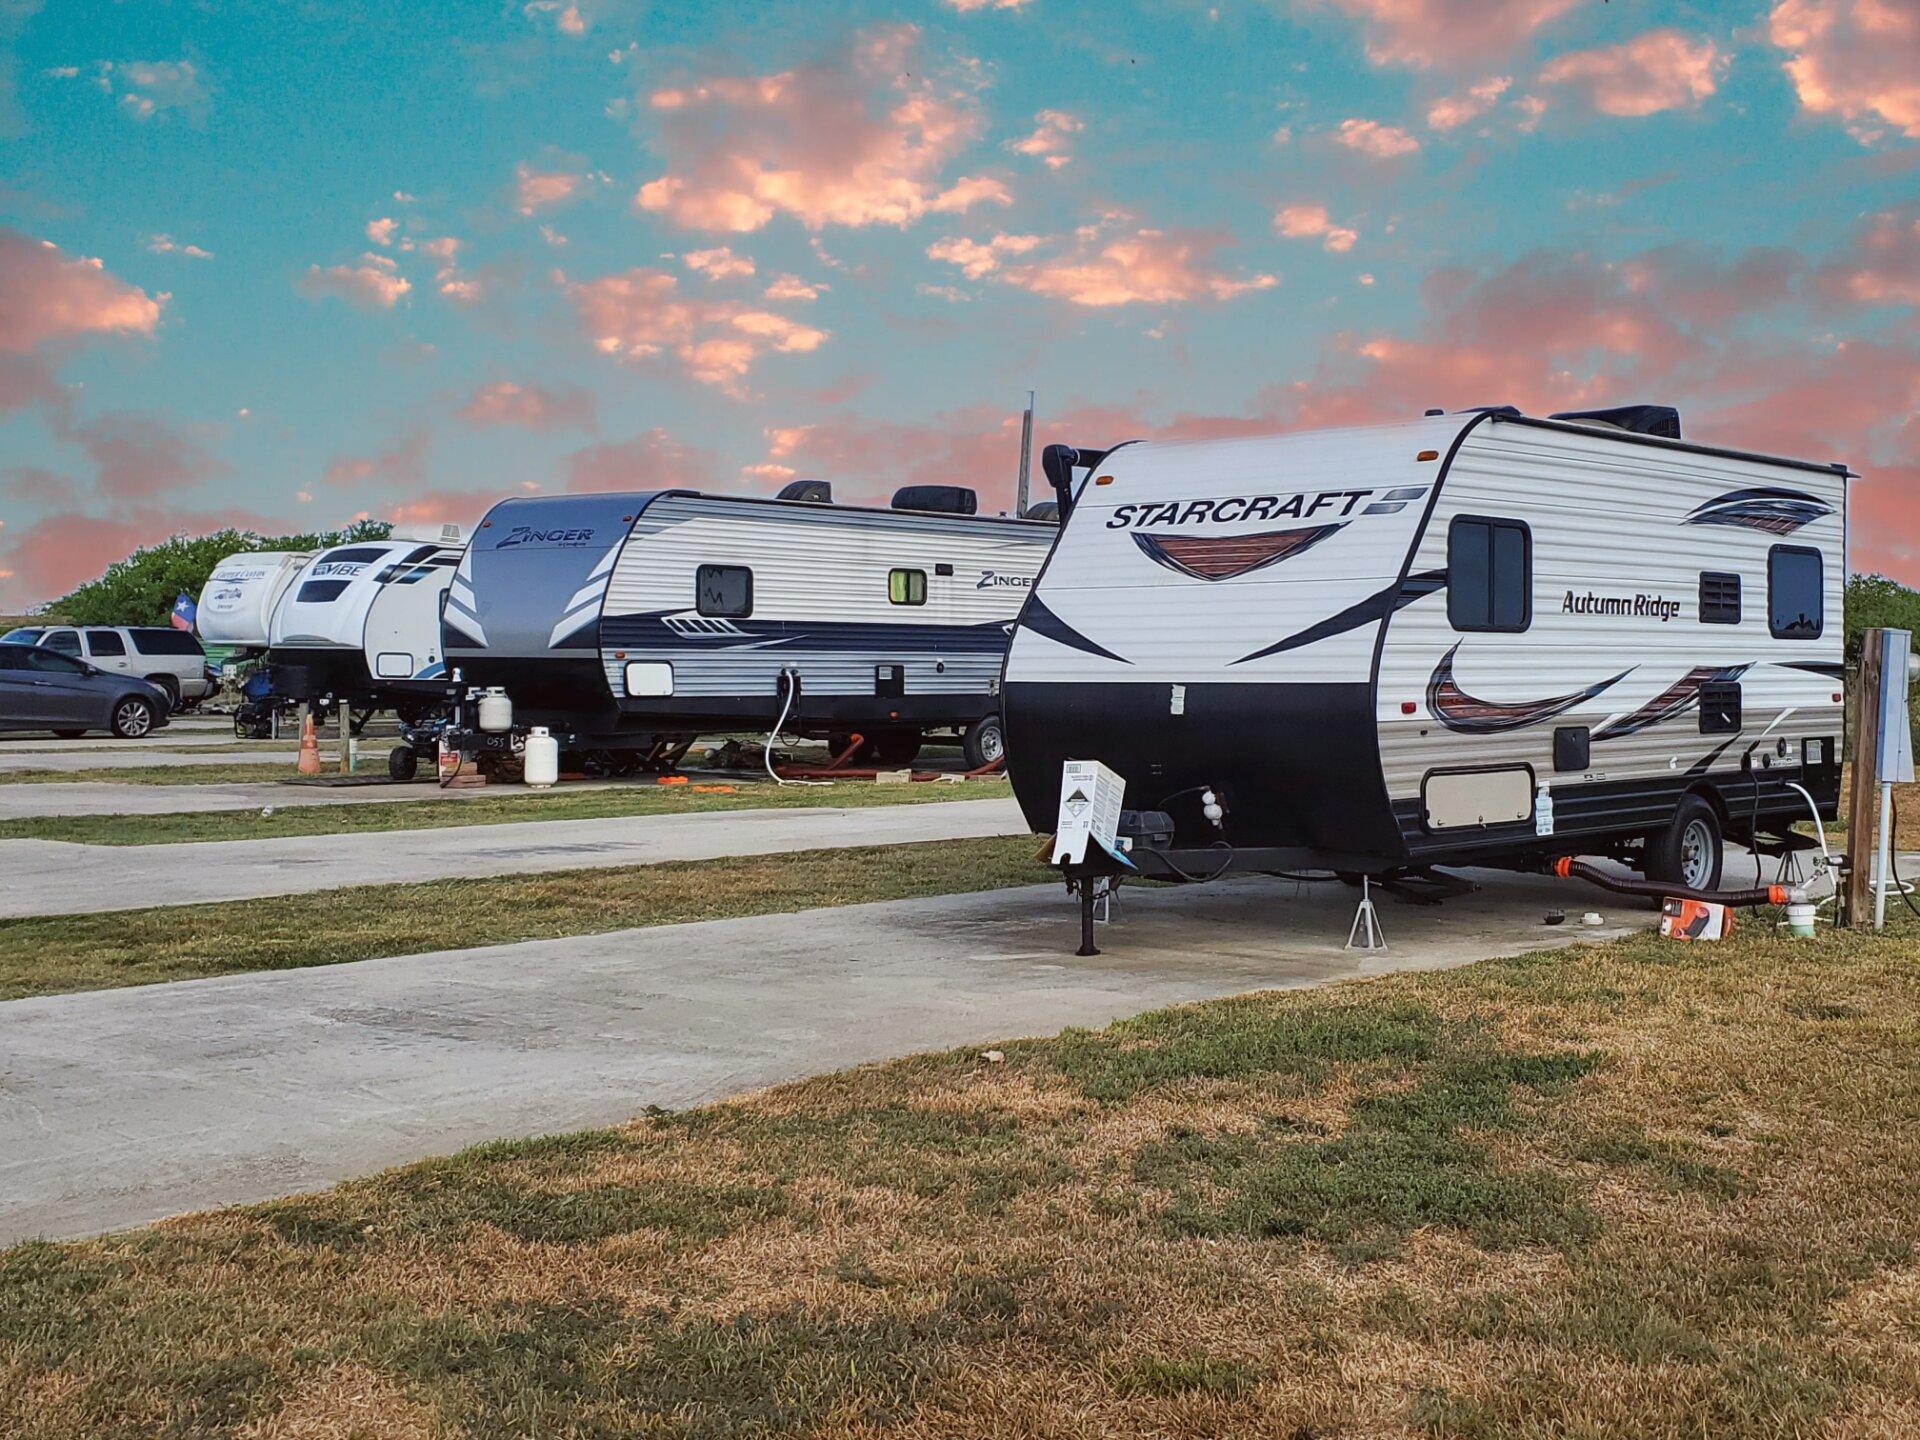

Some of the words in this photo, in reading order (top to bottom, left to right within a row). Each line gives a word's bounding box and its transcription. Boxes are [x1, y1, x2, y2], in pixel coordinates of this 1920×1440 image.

[1106, 490, 1373, 529] STARCRAFT
[496, 526, 594, 549] ZINGER
[1562, 590, 1631, 615] Autumn
[1633, 594, 1680, 622] Ridge
